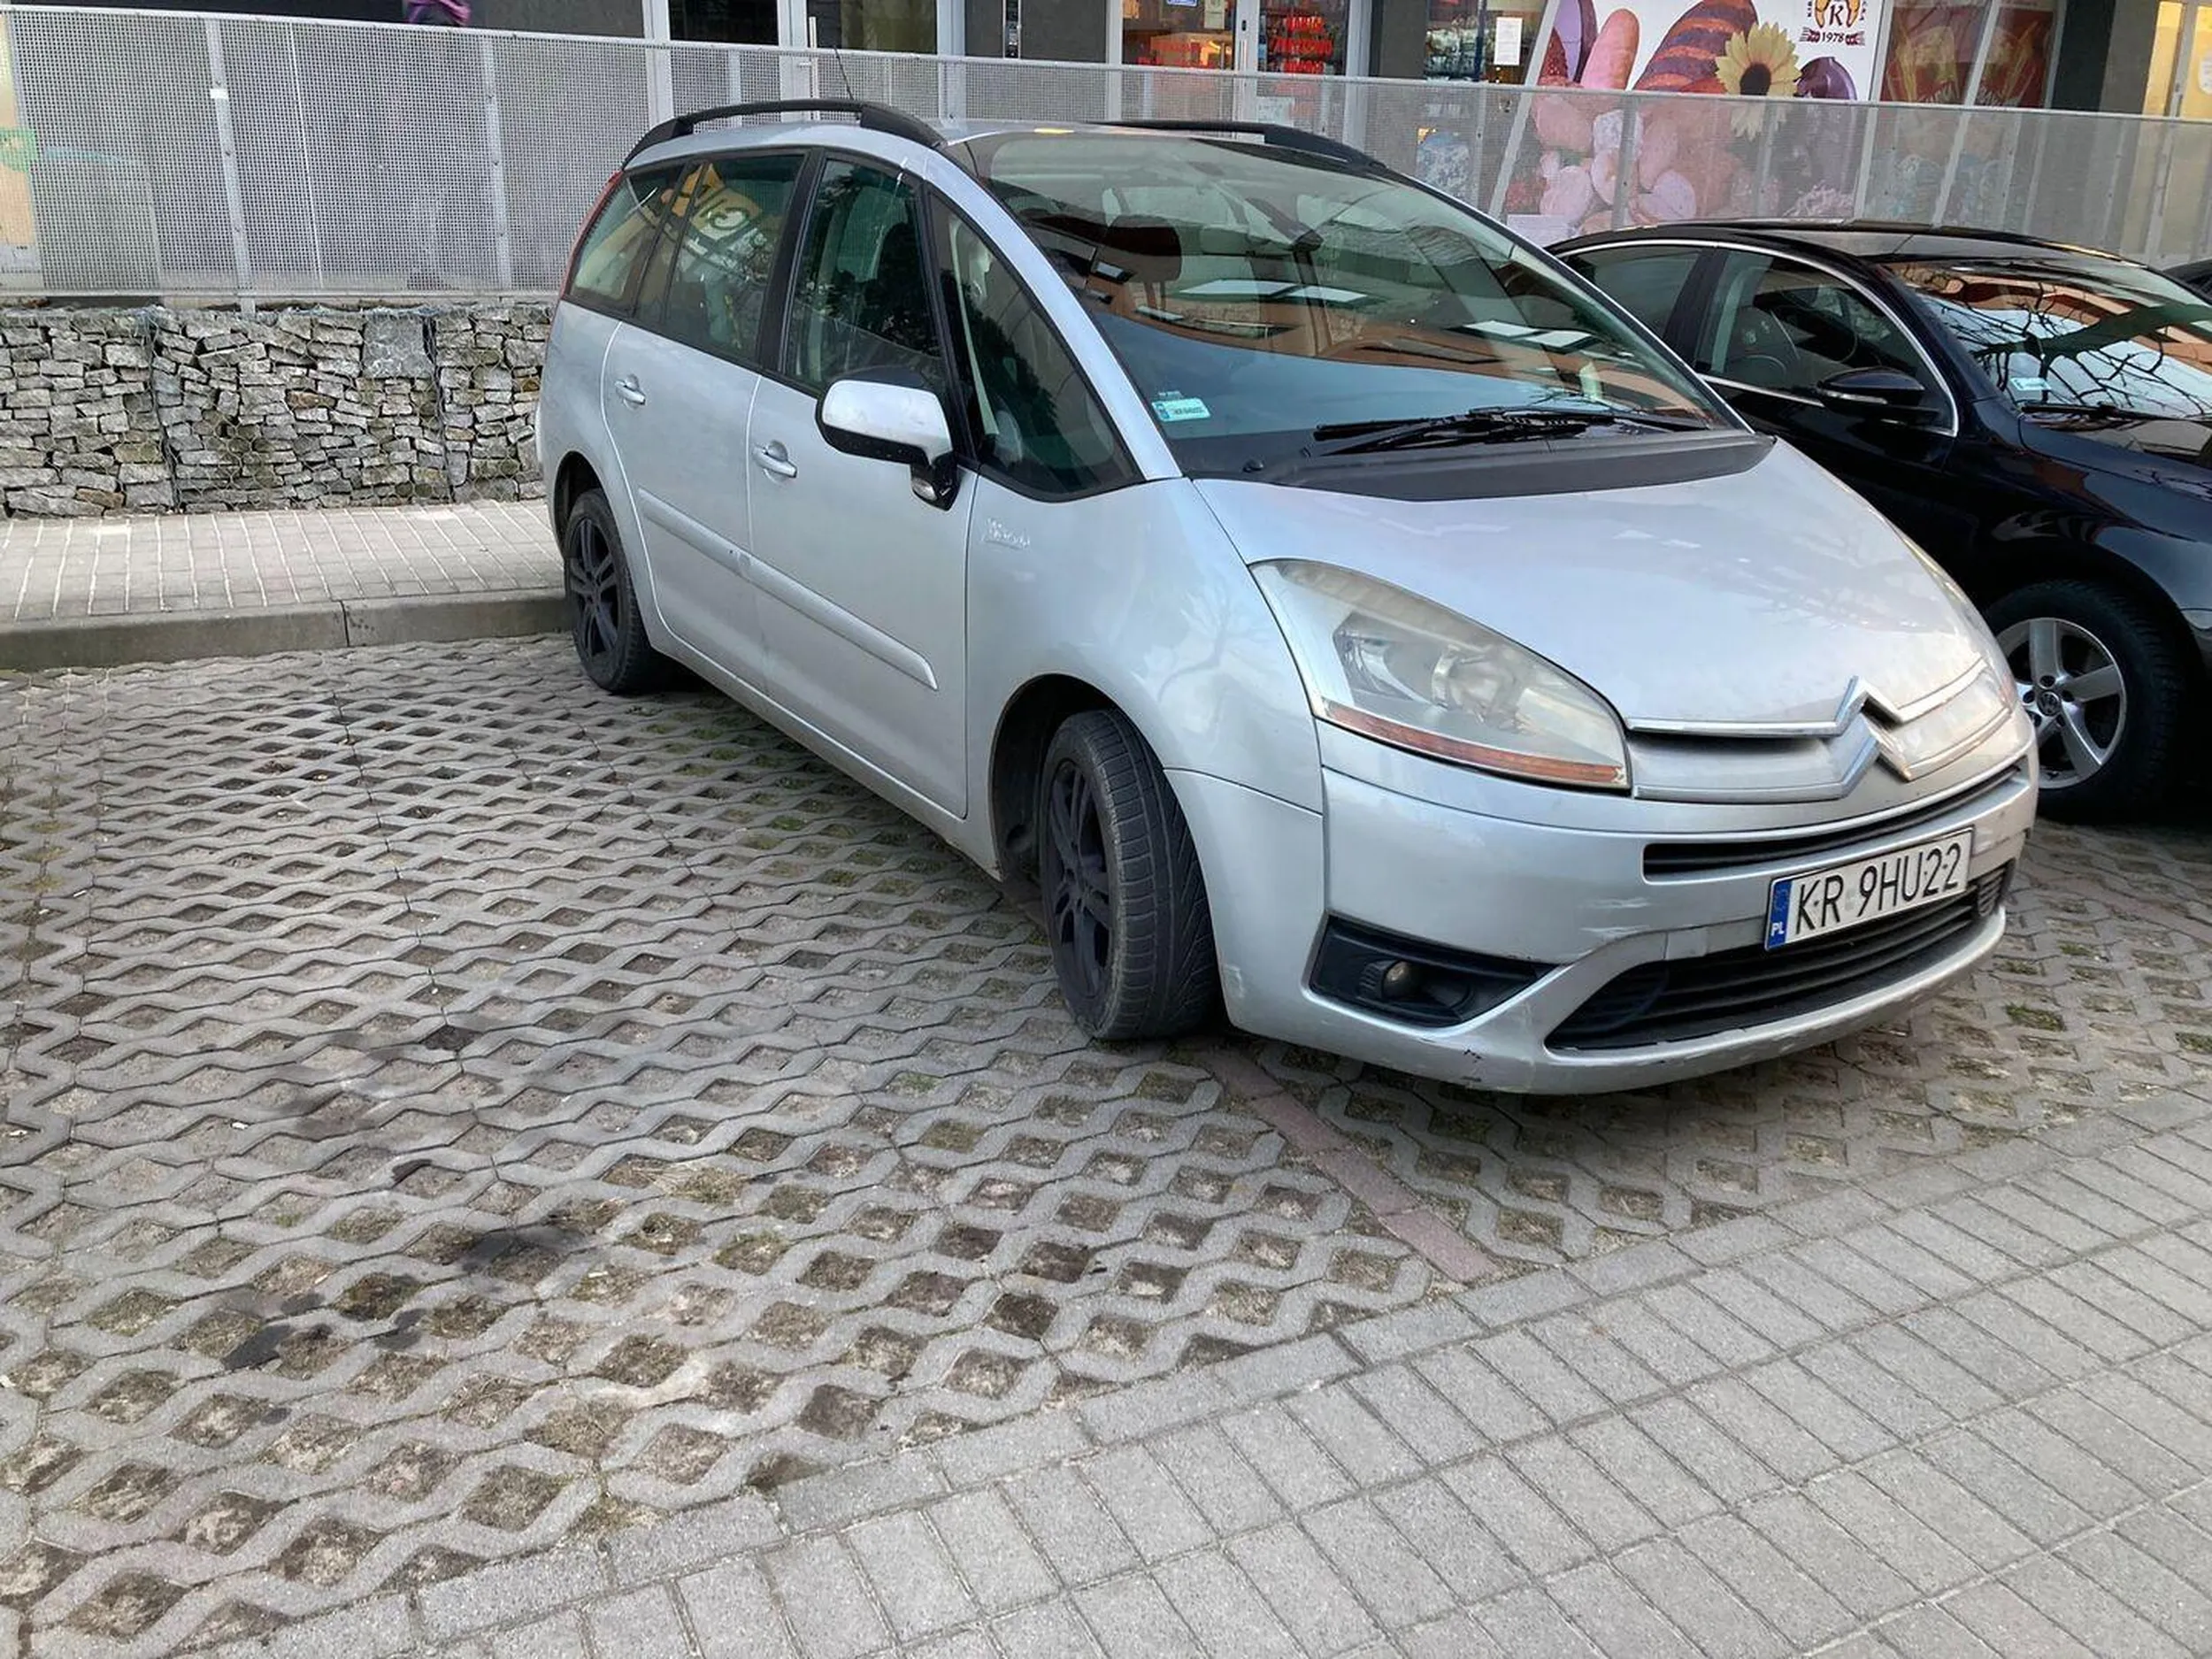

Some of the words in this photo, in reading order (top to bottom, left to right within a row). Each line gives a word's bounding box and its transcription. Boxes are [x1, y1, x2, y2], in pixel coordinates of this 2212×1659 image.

[1822, 32, 1845, 42] 1978
[1795, 874, 1844, 935] KR
[1858, 842, 1962, 918] 9HU22
[1771, 921, 1785, 937] PL
